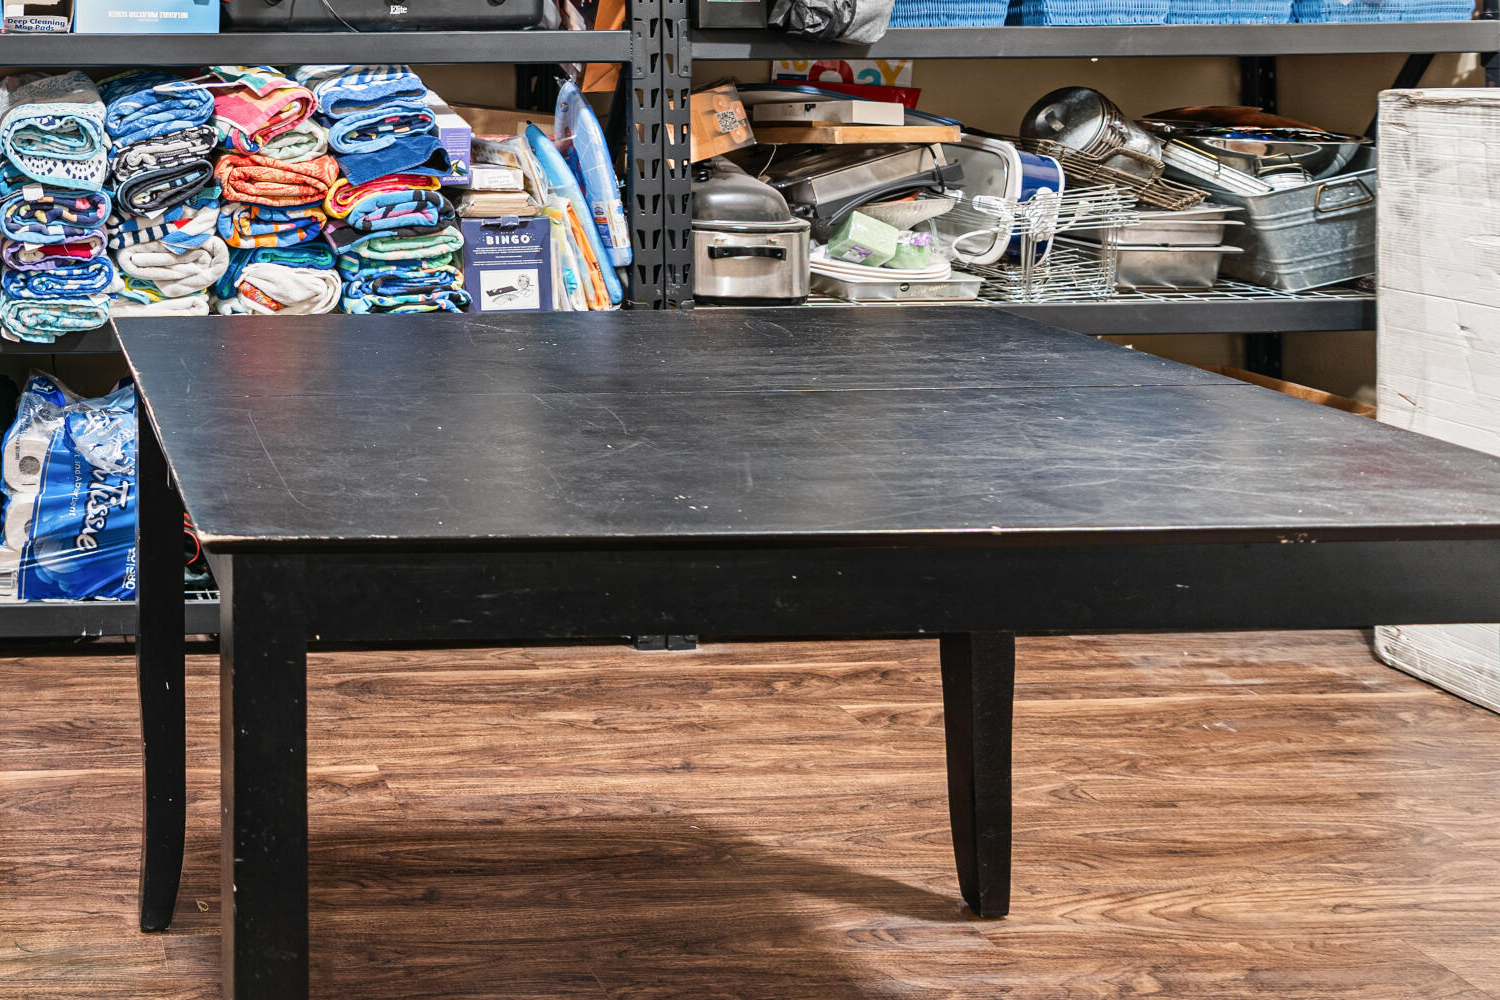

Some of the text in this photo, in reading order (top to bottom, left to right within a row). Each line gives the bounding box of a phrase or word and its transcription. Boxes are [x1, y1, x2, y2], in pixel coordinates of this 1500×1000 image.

[7, 18, 65, 27] Deep Cleaning
[485, 234, 530, 245] BINGO
